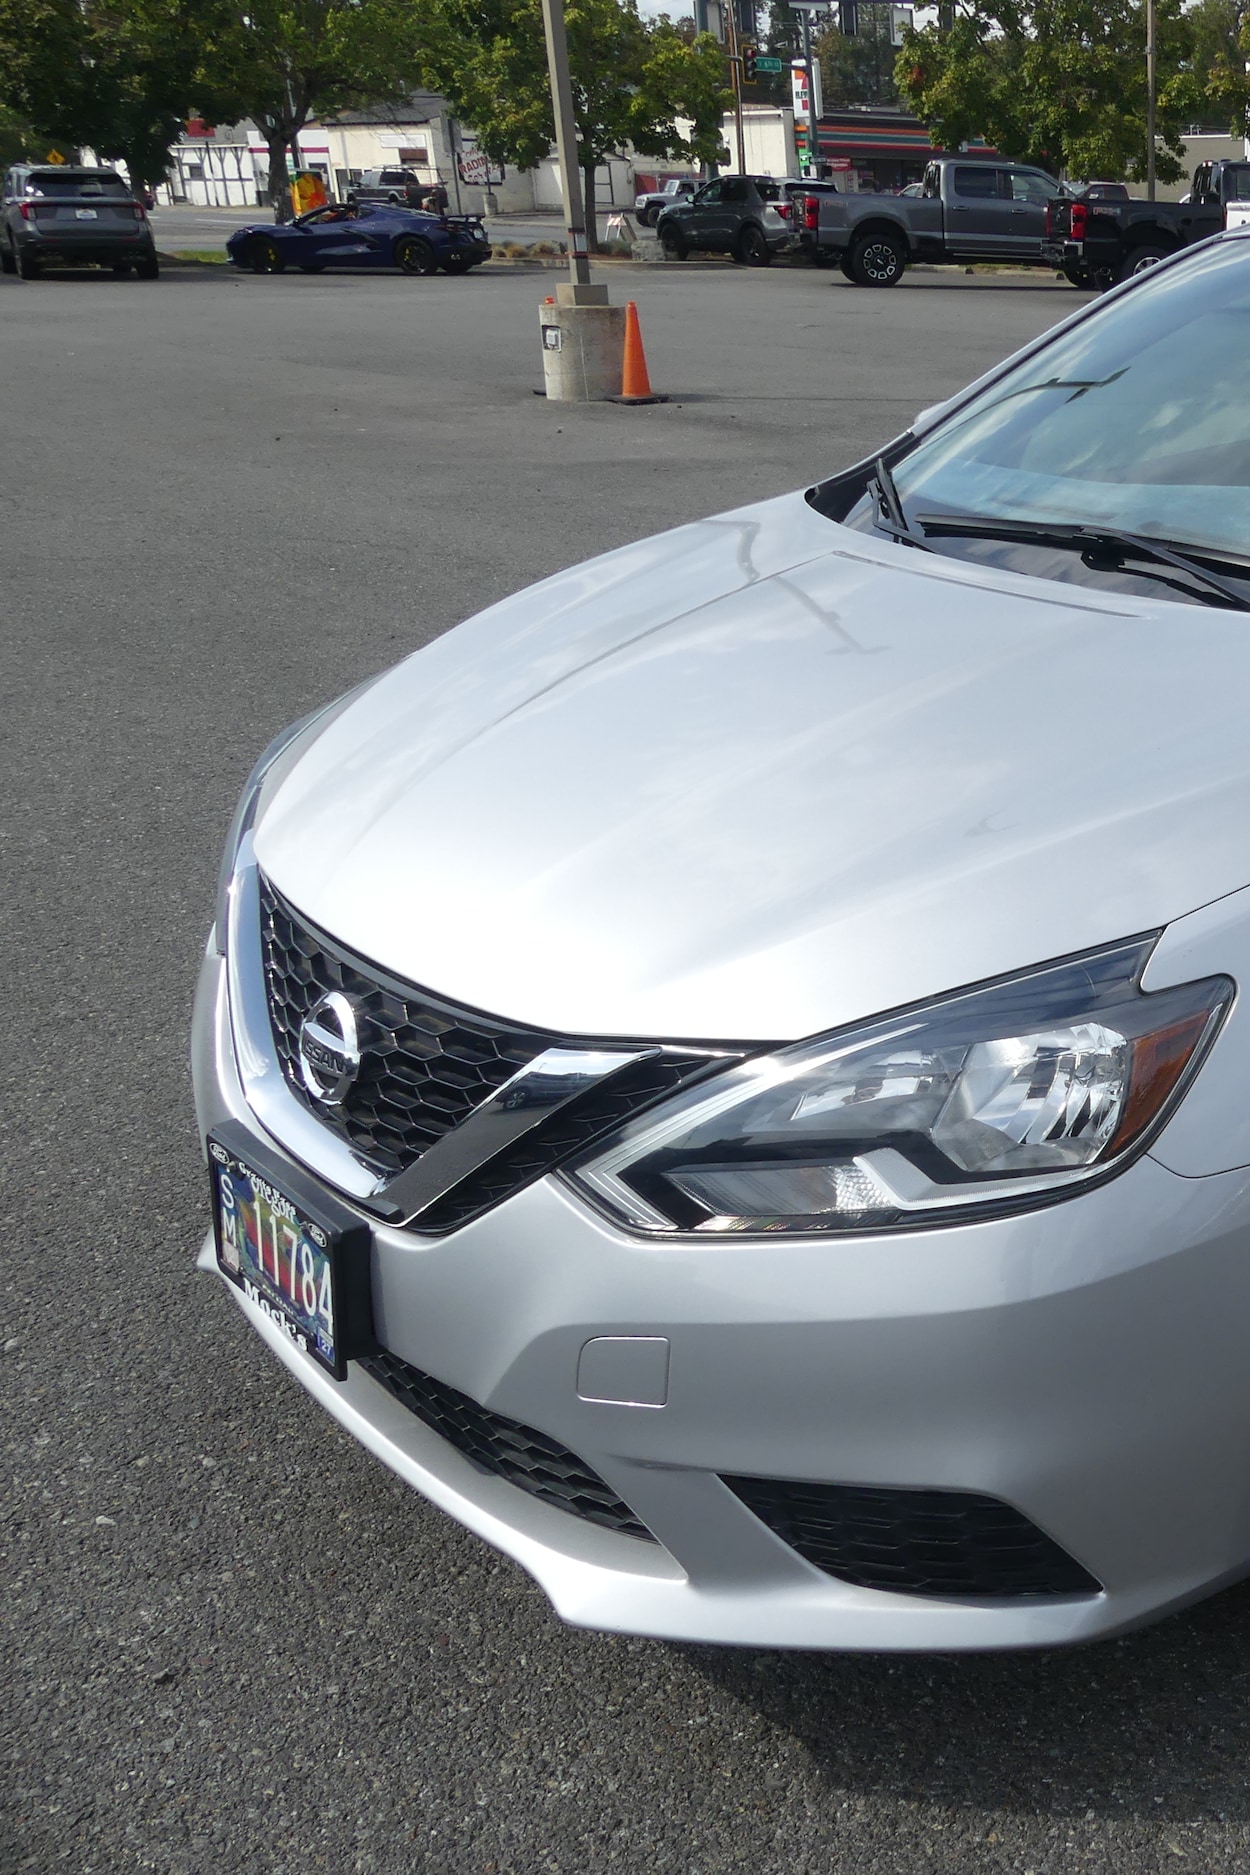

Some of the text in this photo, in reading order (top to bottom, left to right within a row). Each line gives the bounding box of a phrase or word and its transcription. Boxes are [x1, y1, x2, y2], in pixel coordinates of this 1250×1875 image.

[795, 91, 808, 99] ELEV
[305, 1040, 343, 1074] SSAN
[253, 1200, 334, 1337] 11784
[243, 1277, 308, 1351] Mock's
[321, 1341, 331, 1355] 27
